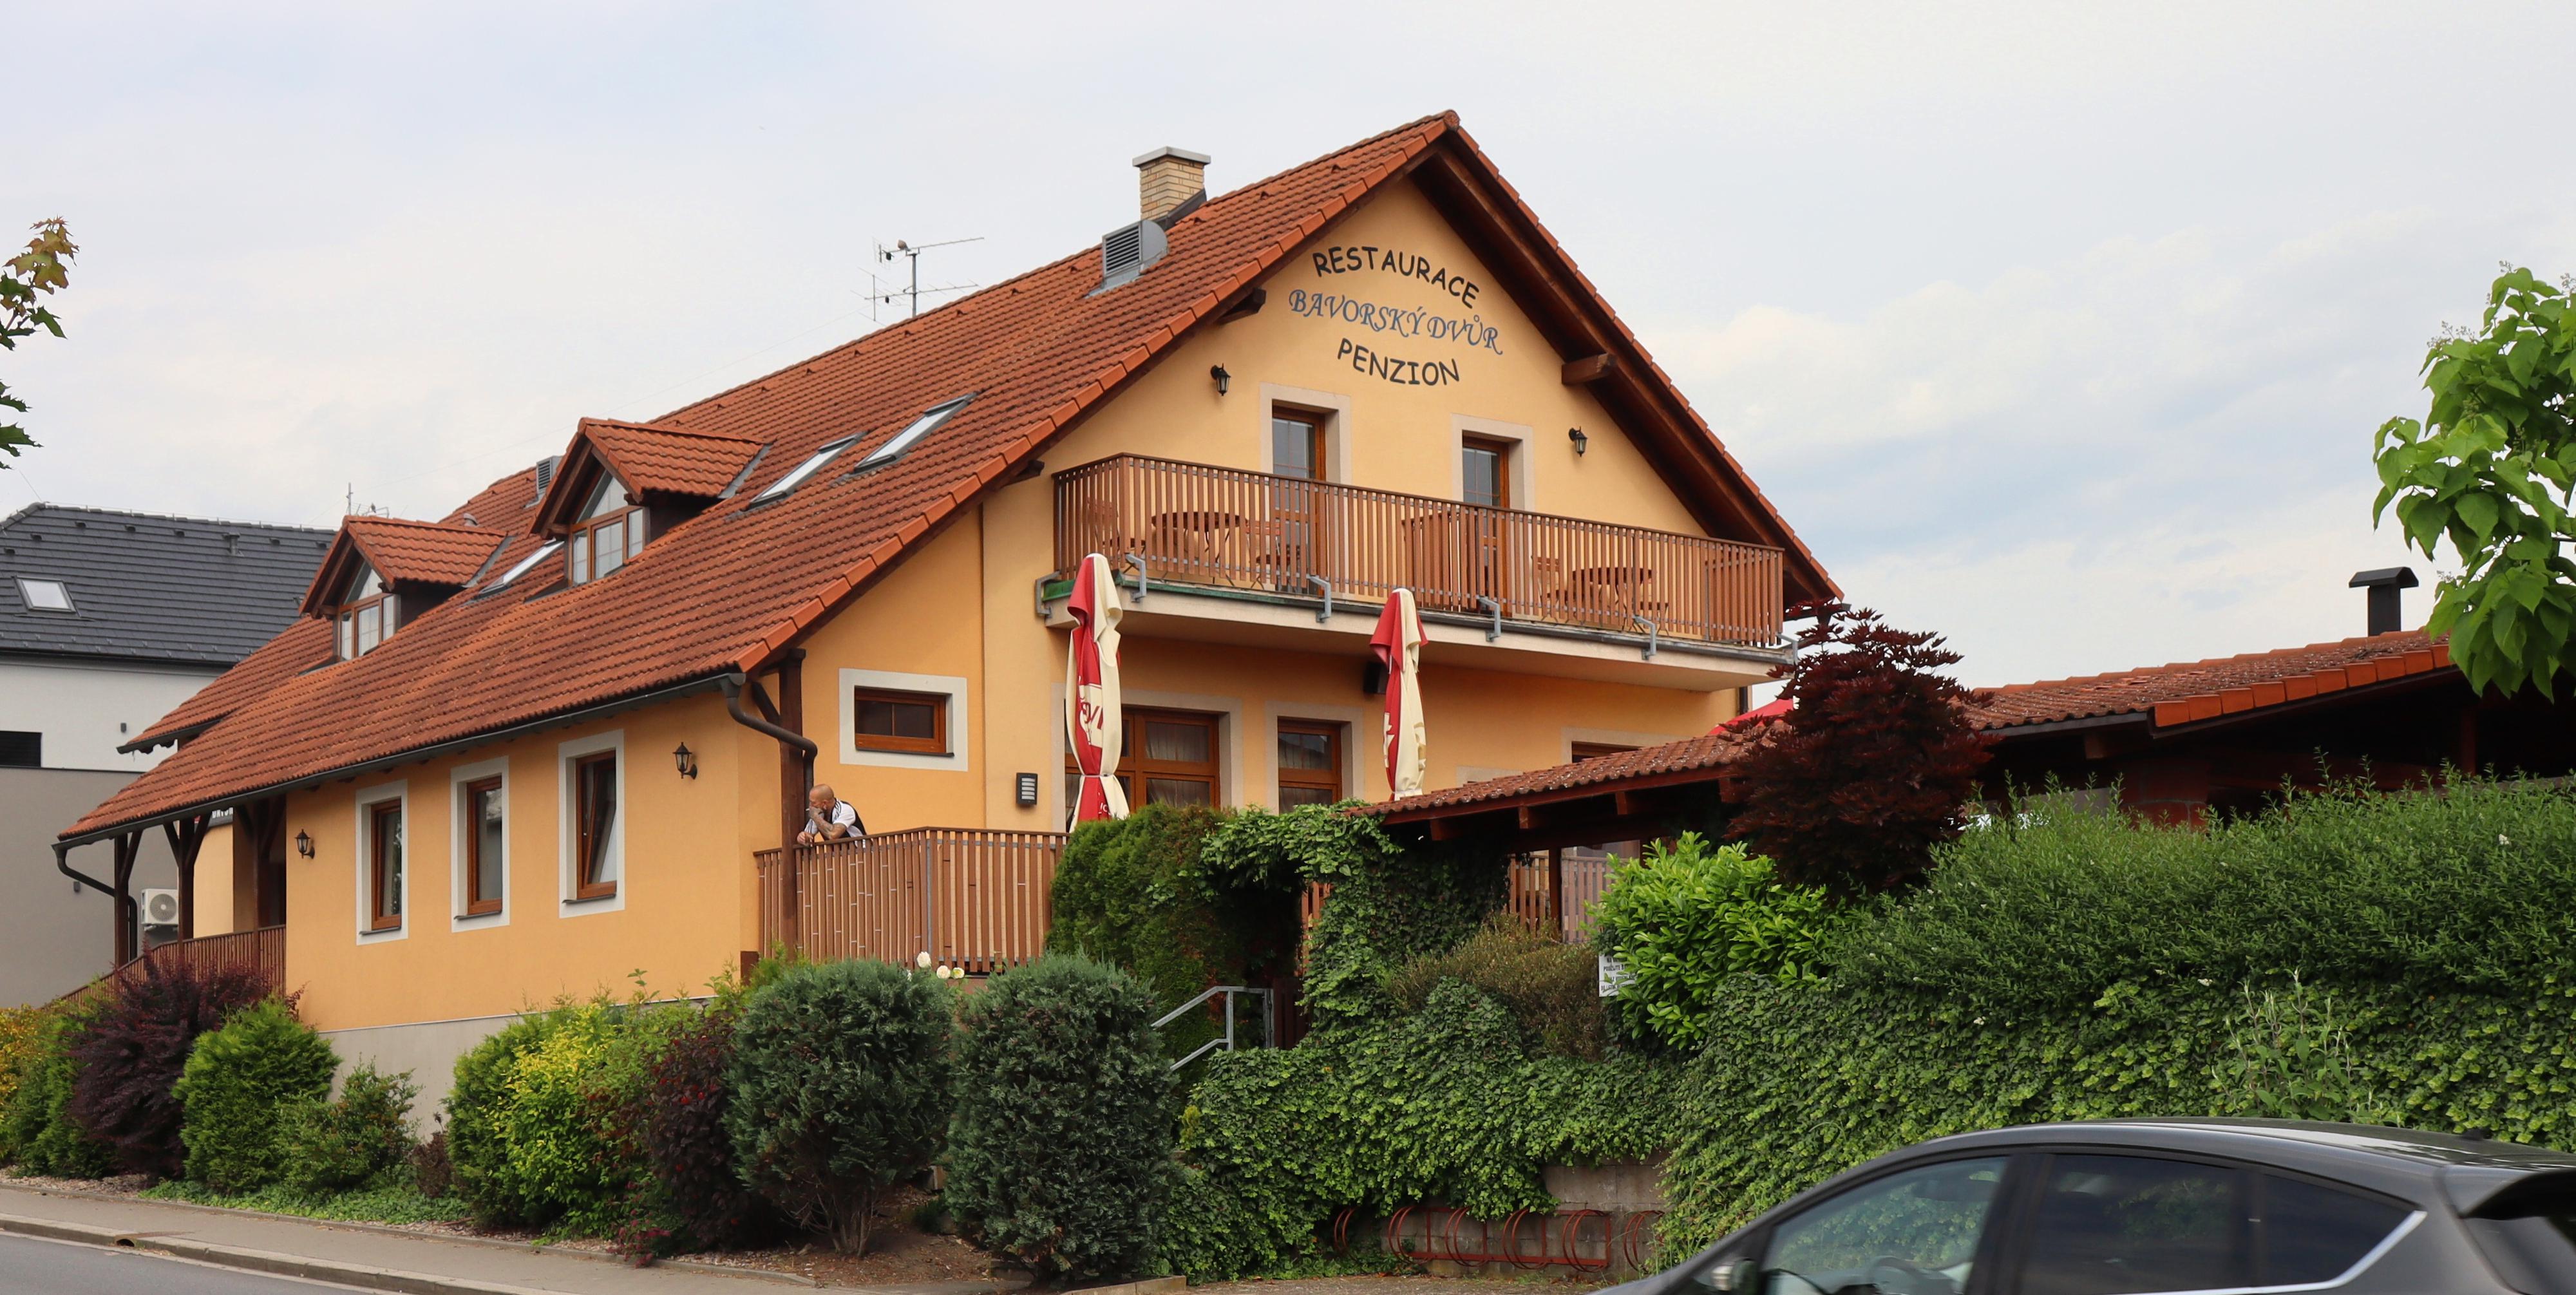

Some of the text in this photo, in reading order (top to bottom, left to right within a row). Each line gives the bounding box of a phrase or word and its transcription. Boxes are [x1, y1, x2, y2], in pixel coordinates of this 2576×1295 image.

[1312, 246, 1479, 308] RESTAURACE
[1289, 289, 1503, 355] BAVORSKÝ DVŮR
[1337, 338, 1459, 385] PENZION
